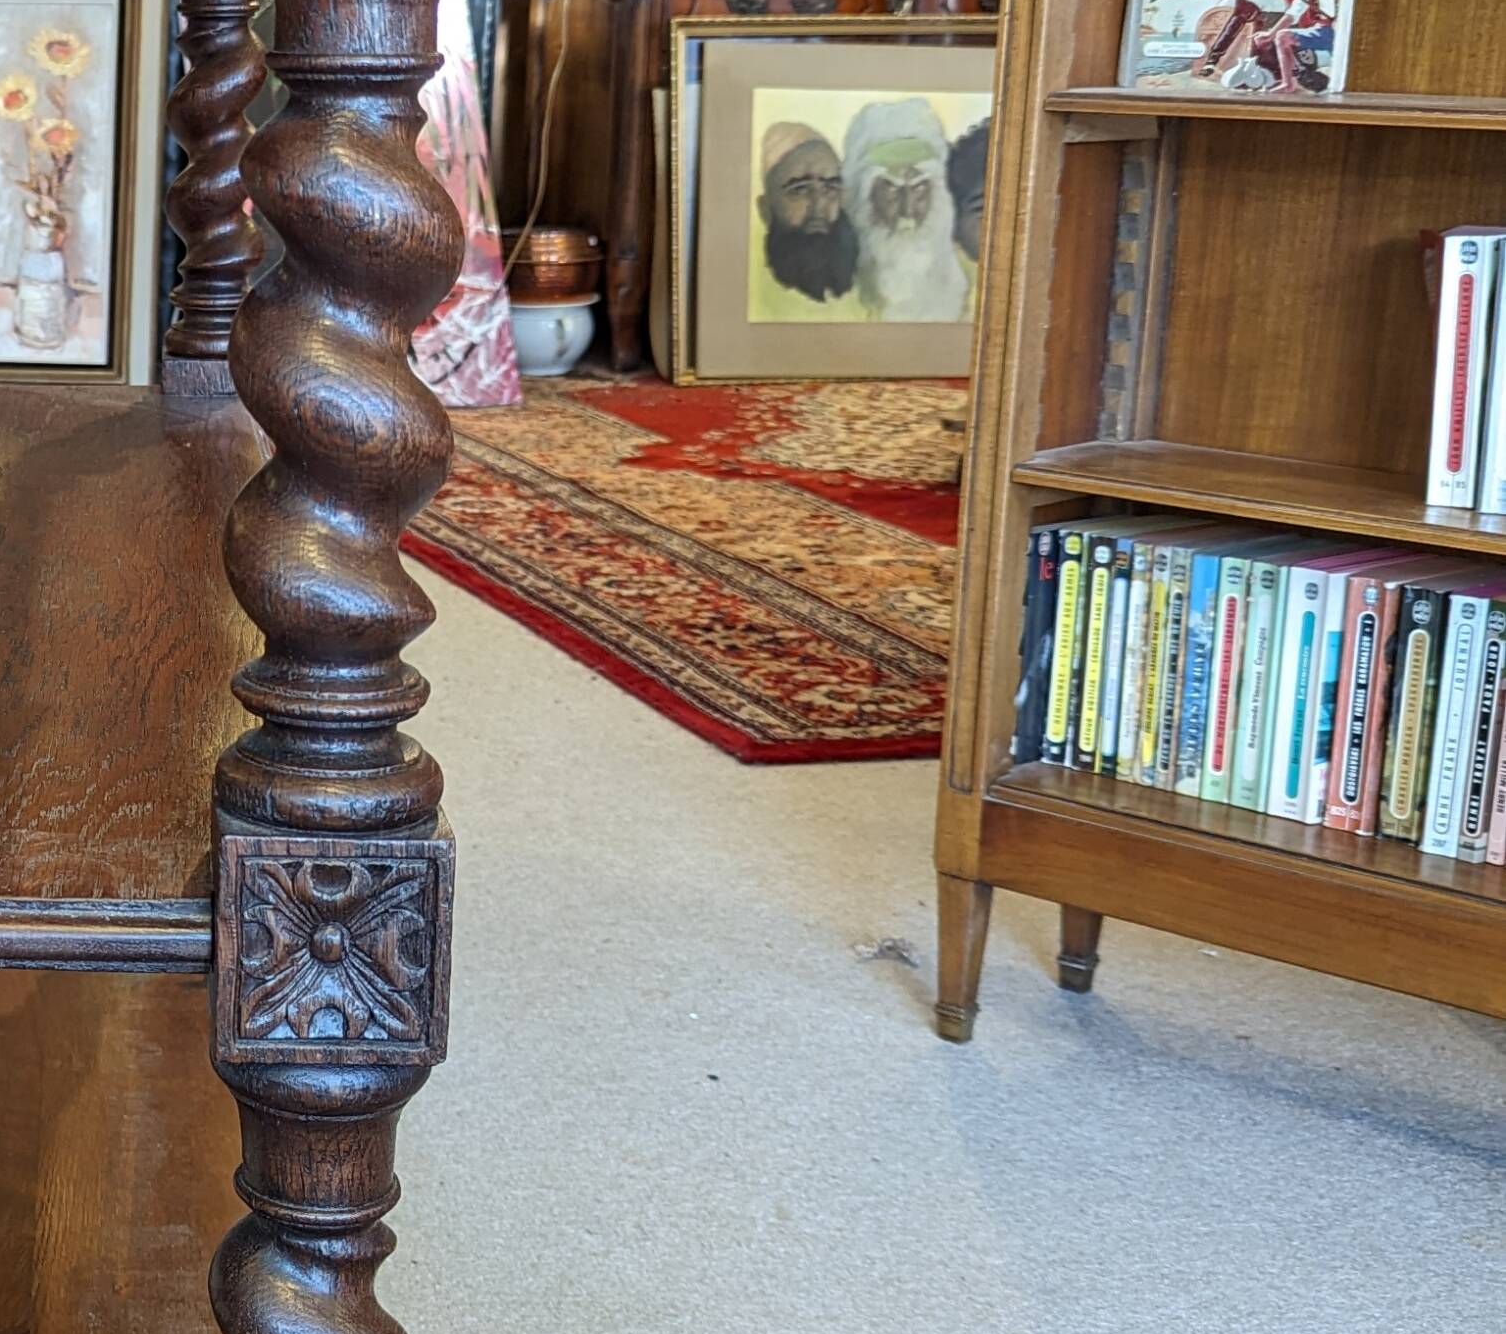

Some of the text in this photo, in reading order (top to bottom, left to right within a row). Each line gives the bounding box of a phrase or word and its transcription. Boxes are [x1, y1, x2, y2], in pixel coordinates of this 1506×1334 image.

[1438, 631, 1470, 827] ANNE FRANK JOURNAL
[1473, 740, 1487, 784] TROYAT
[1468, 795, 1481, 829] HENRI
